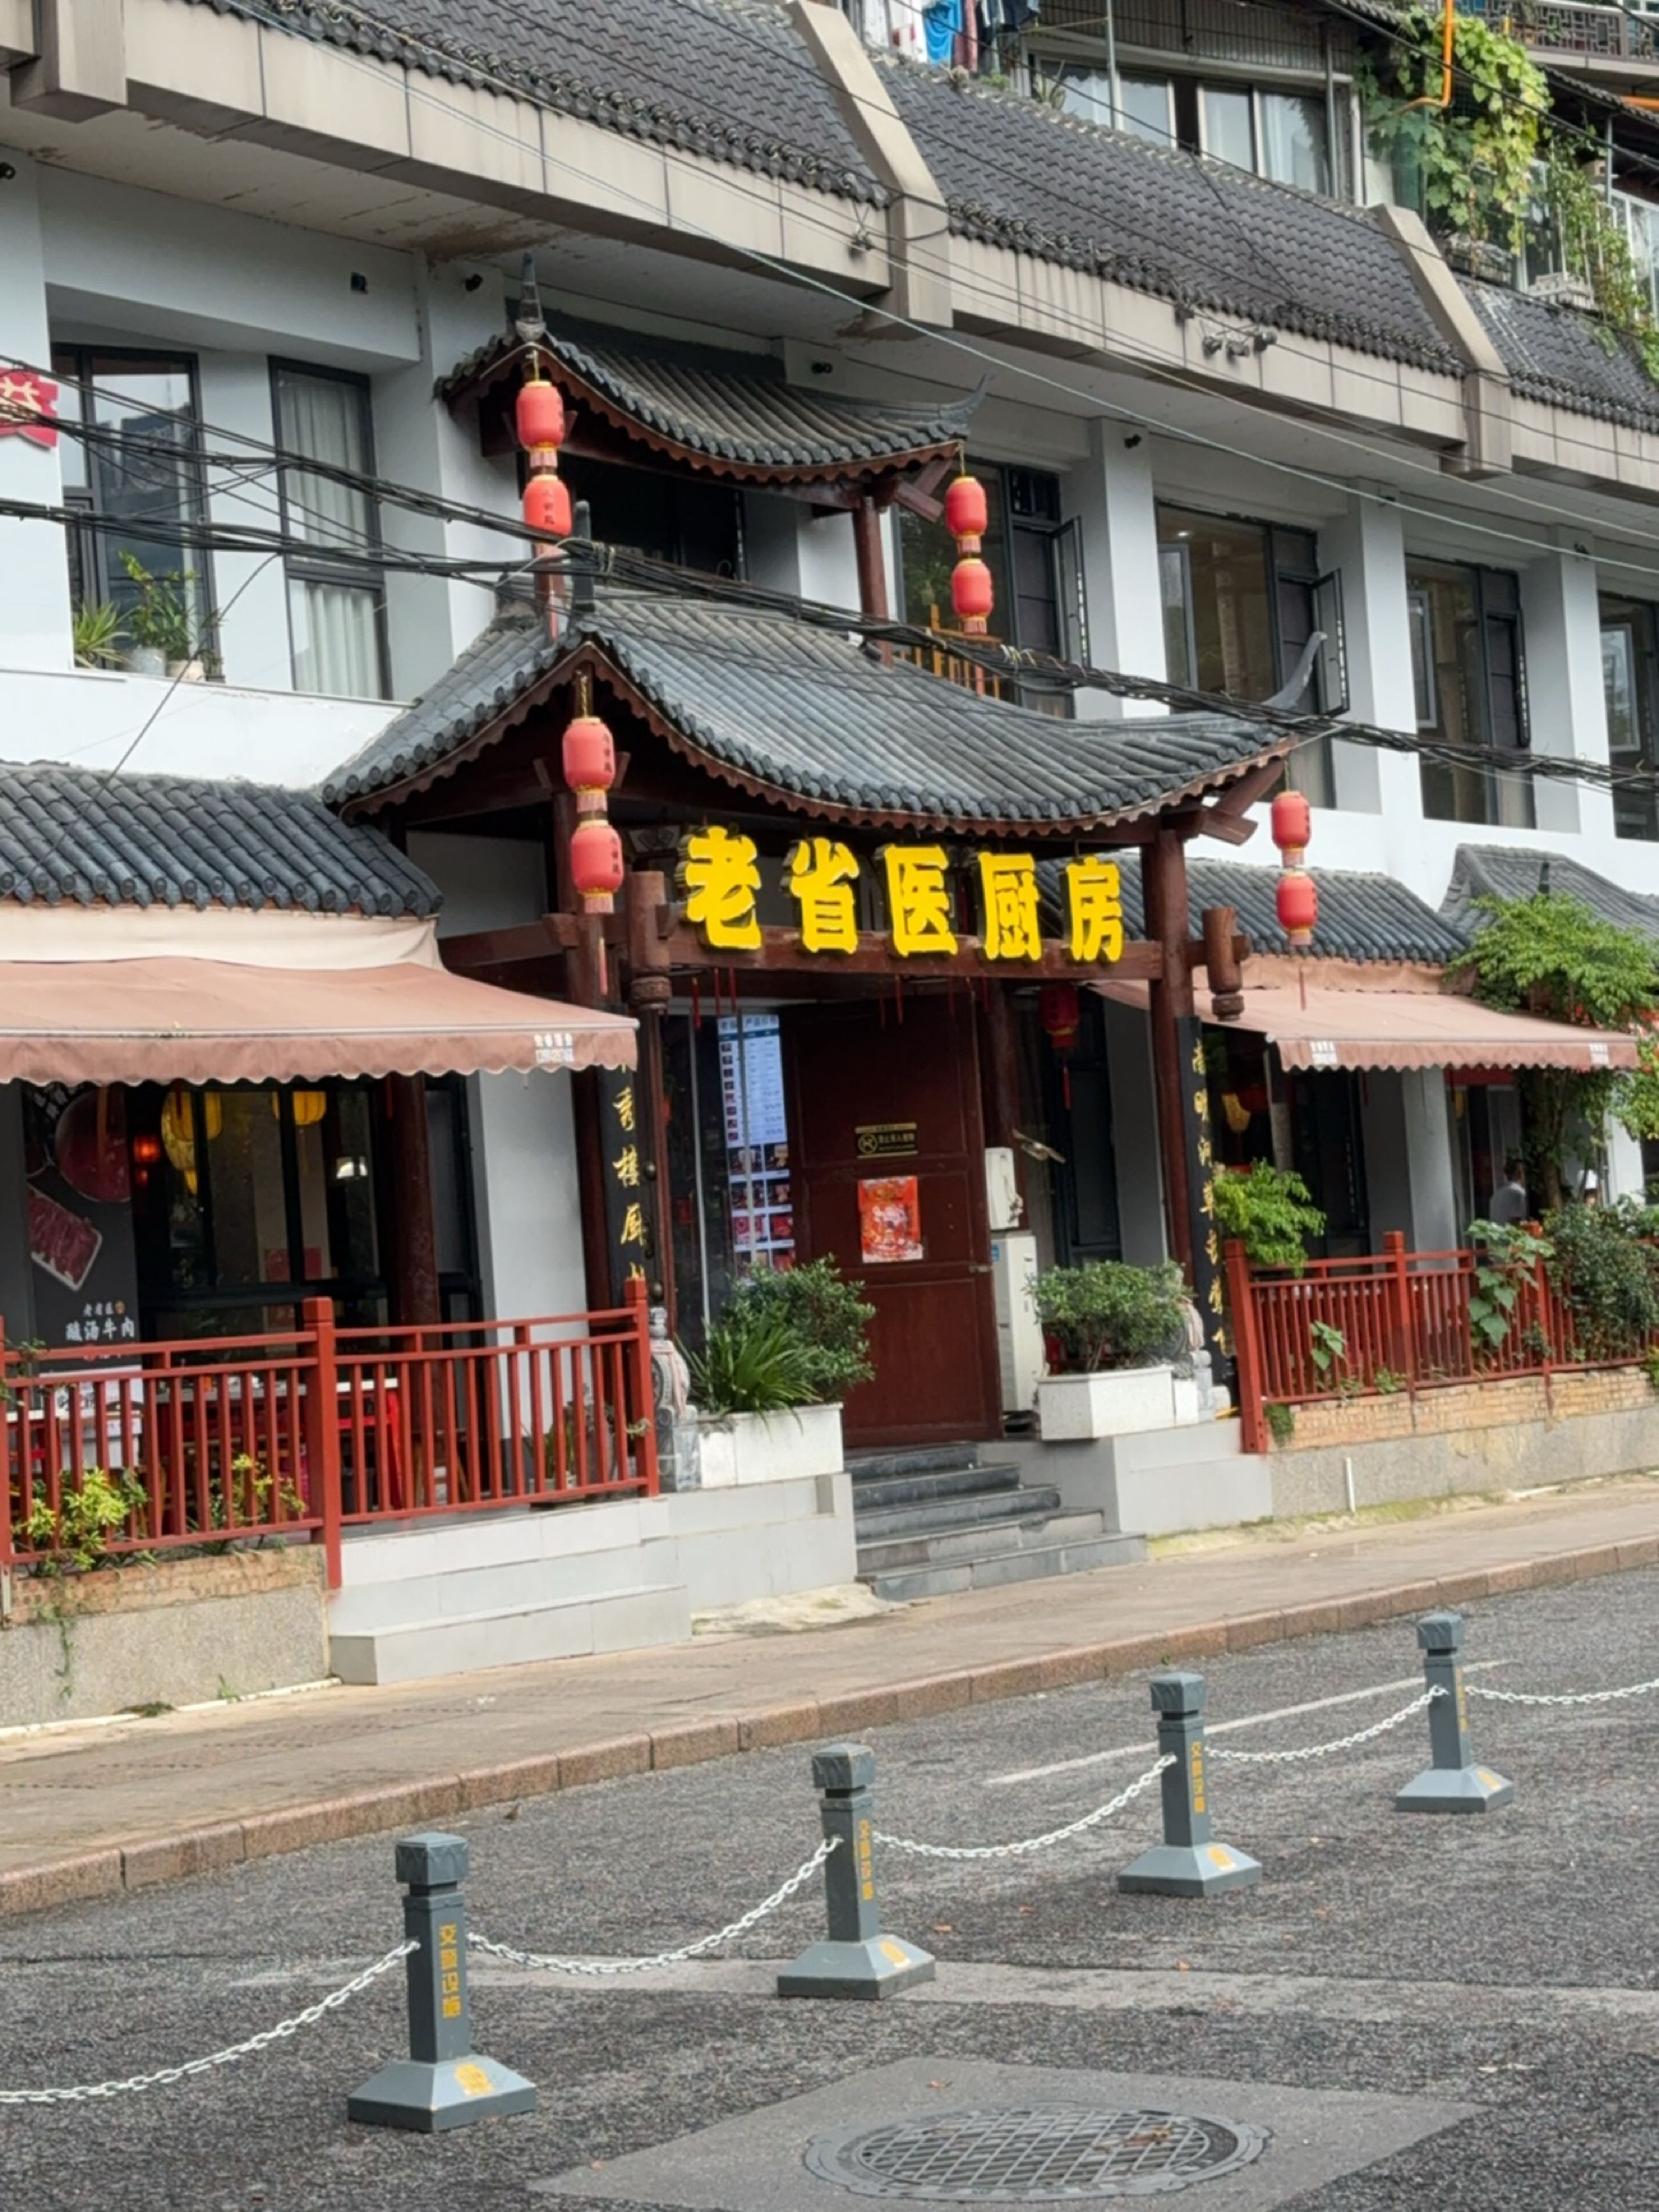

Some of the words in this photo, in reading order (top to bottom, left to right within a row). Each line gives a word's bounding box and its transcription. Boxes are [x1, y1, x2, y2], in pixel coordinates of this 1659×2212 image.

[682, 826, 1123, 961] 老省医厨房
